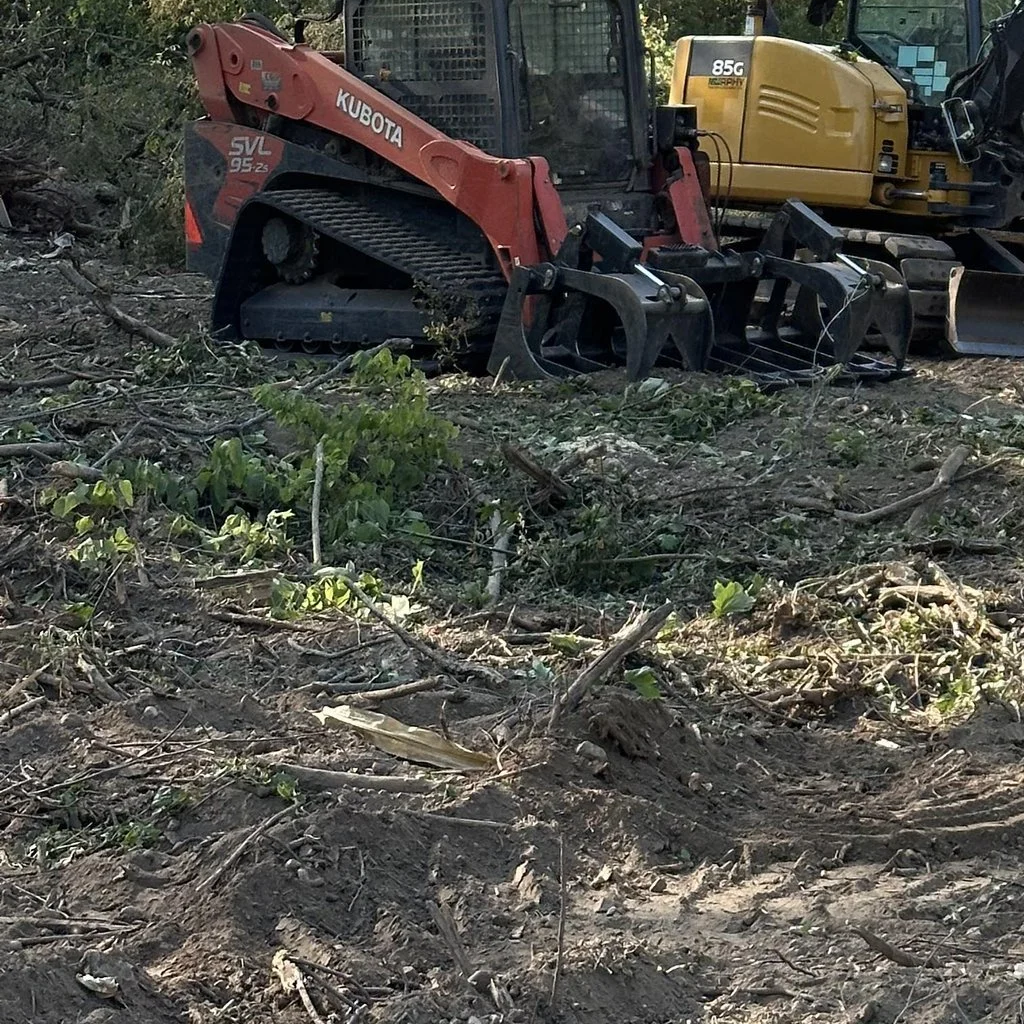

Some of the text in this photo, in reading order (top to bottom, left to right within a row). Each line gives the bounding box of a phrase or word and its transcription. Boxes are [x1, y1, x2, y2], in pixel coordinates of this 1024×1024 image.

[712, 59, 744, 76] 85G
[336, 88, 404, 148] KUBOTA
[228, 136, 272, 156] SVL
